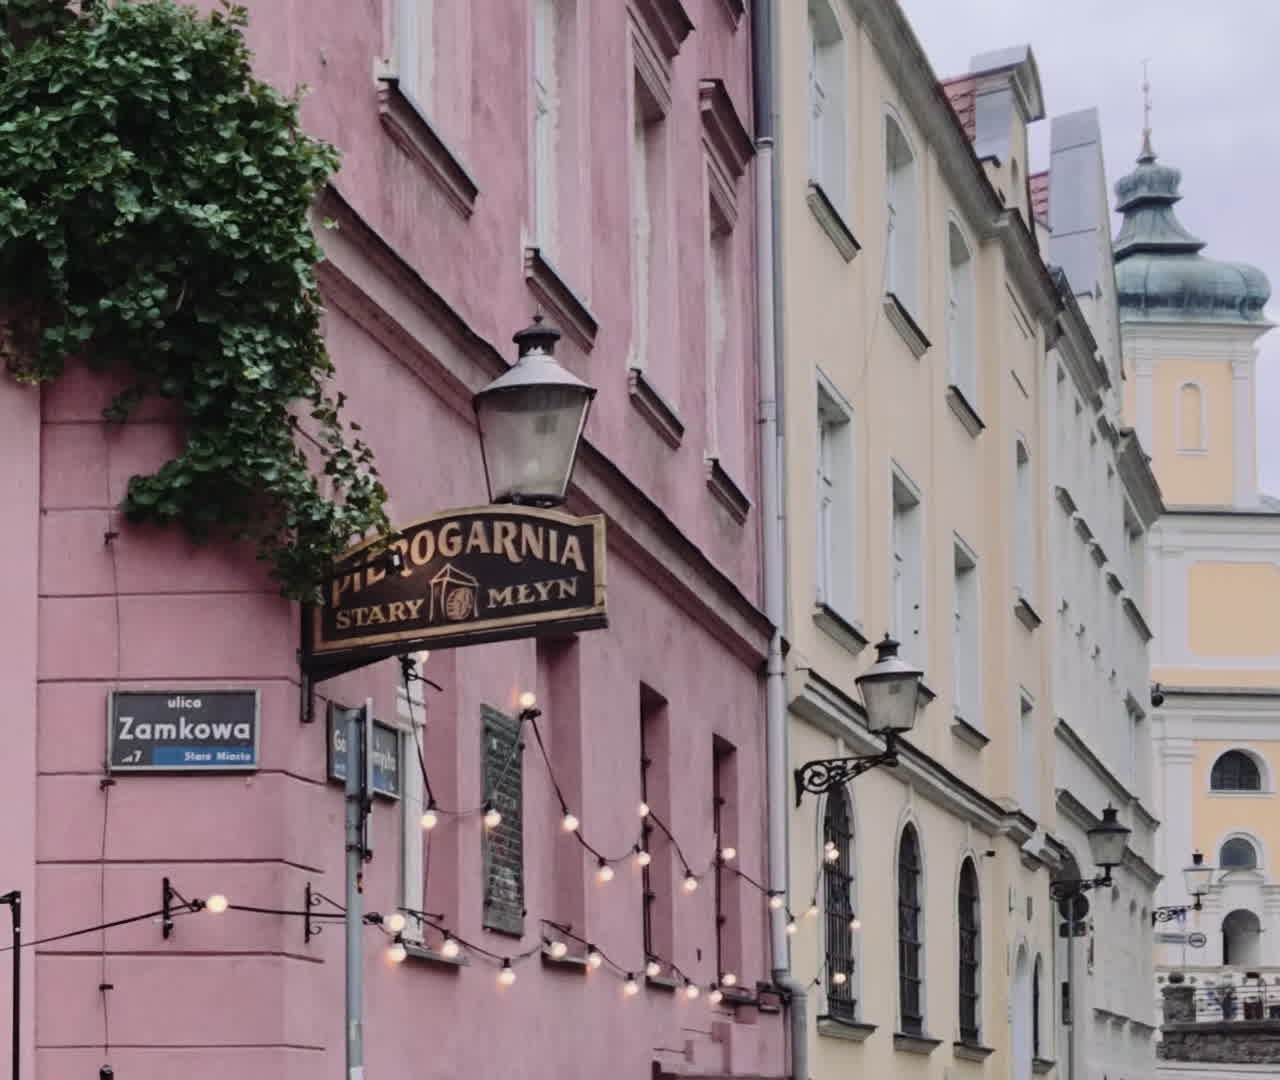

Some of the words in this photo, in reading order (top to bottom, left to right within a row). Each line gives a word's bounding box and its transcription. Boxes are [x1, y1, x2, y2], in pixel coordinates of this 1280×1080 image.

[336, 599, 425, 630] STARY
[487, 577, 578, 609] MŁYN
[168, 696, 202, 709] ulica
[119, 716, 251, 740] Zamkowa
